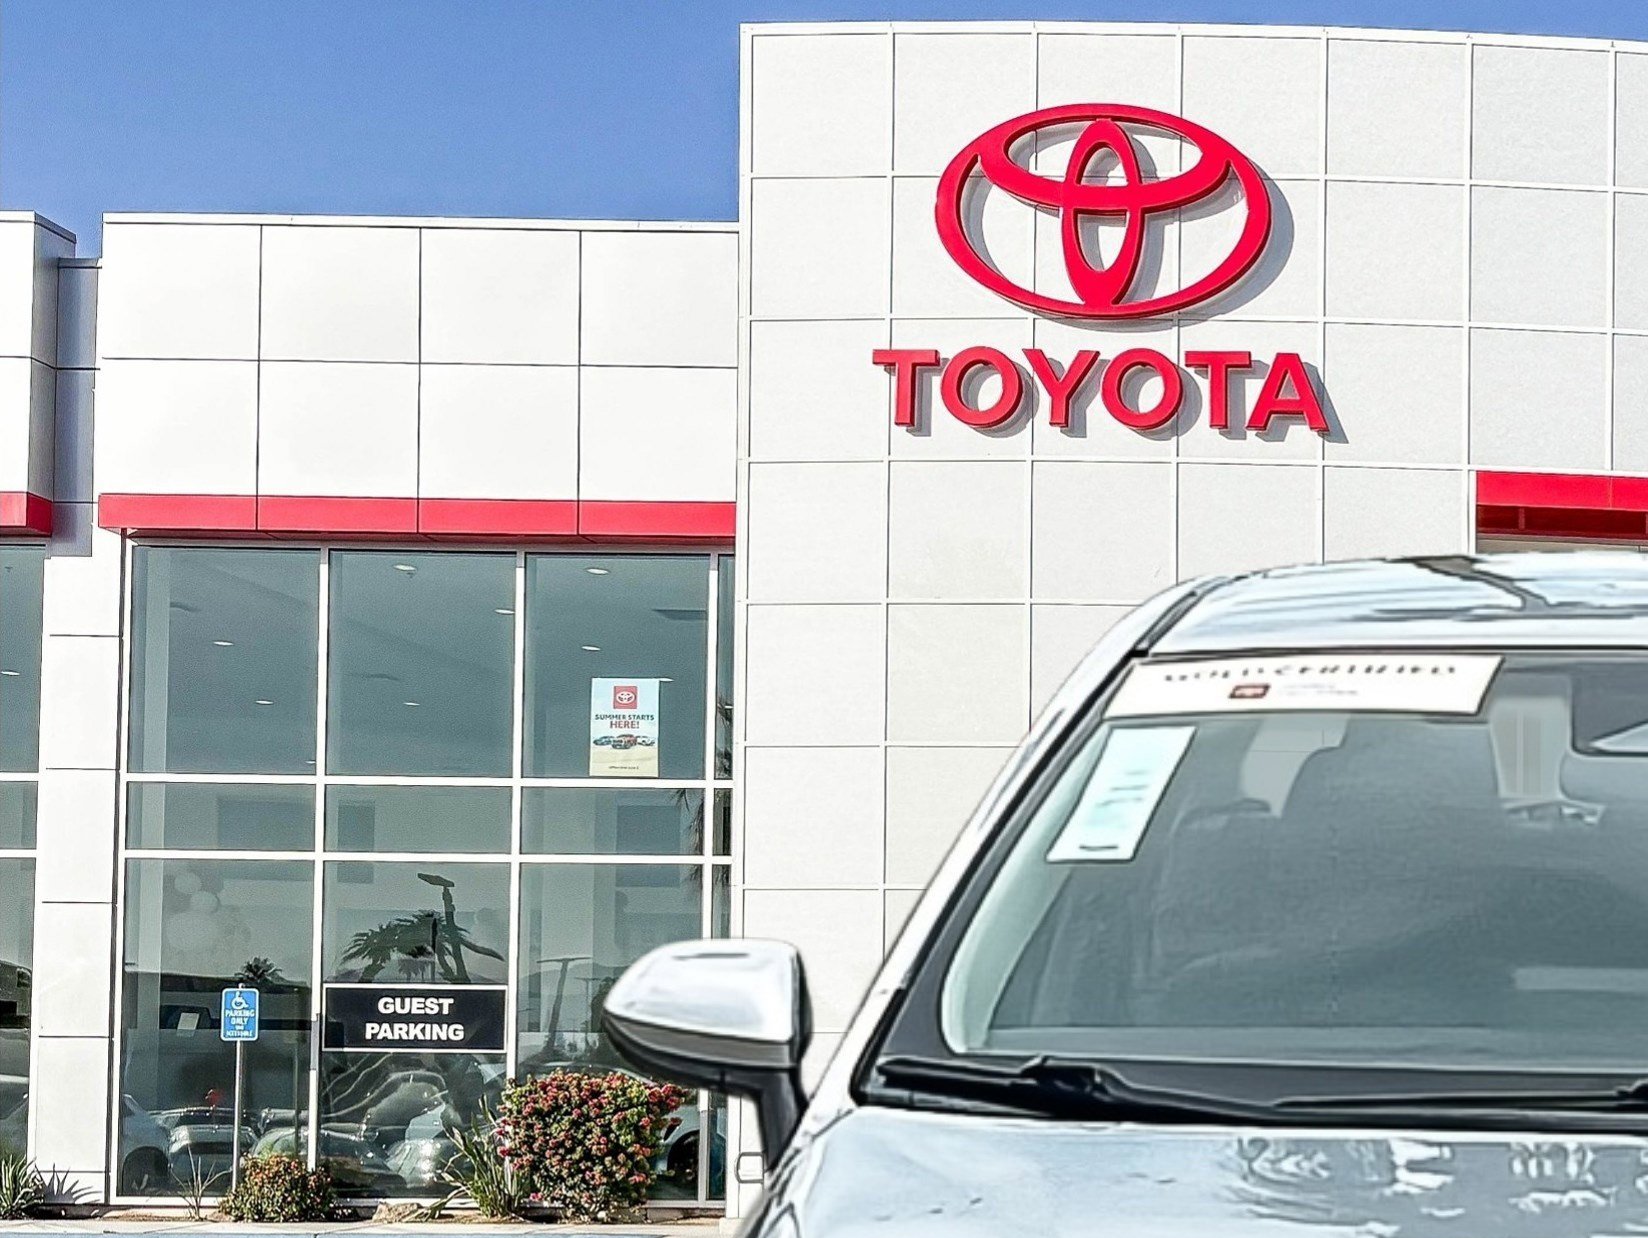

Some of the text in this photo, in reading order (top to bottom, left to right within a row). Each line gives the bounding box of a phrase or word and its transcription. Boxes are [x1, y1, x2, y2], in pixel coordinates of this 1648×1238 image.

[872, 346, 1330, 435] TOYOTA
[609, 721, 640, 729] HERE!
[377, 997, 455, 1015] GUEST
[225, 1009, 255, 1017] PARKING
[230, 1017, 249, 1025] ONLY
[365, 1022, 465, 1041] PARKING
